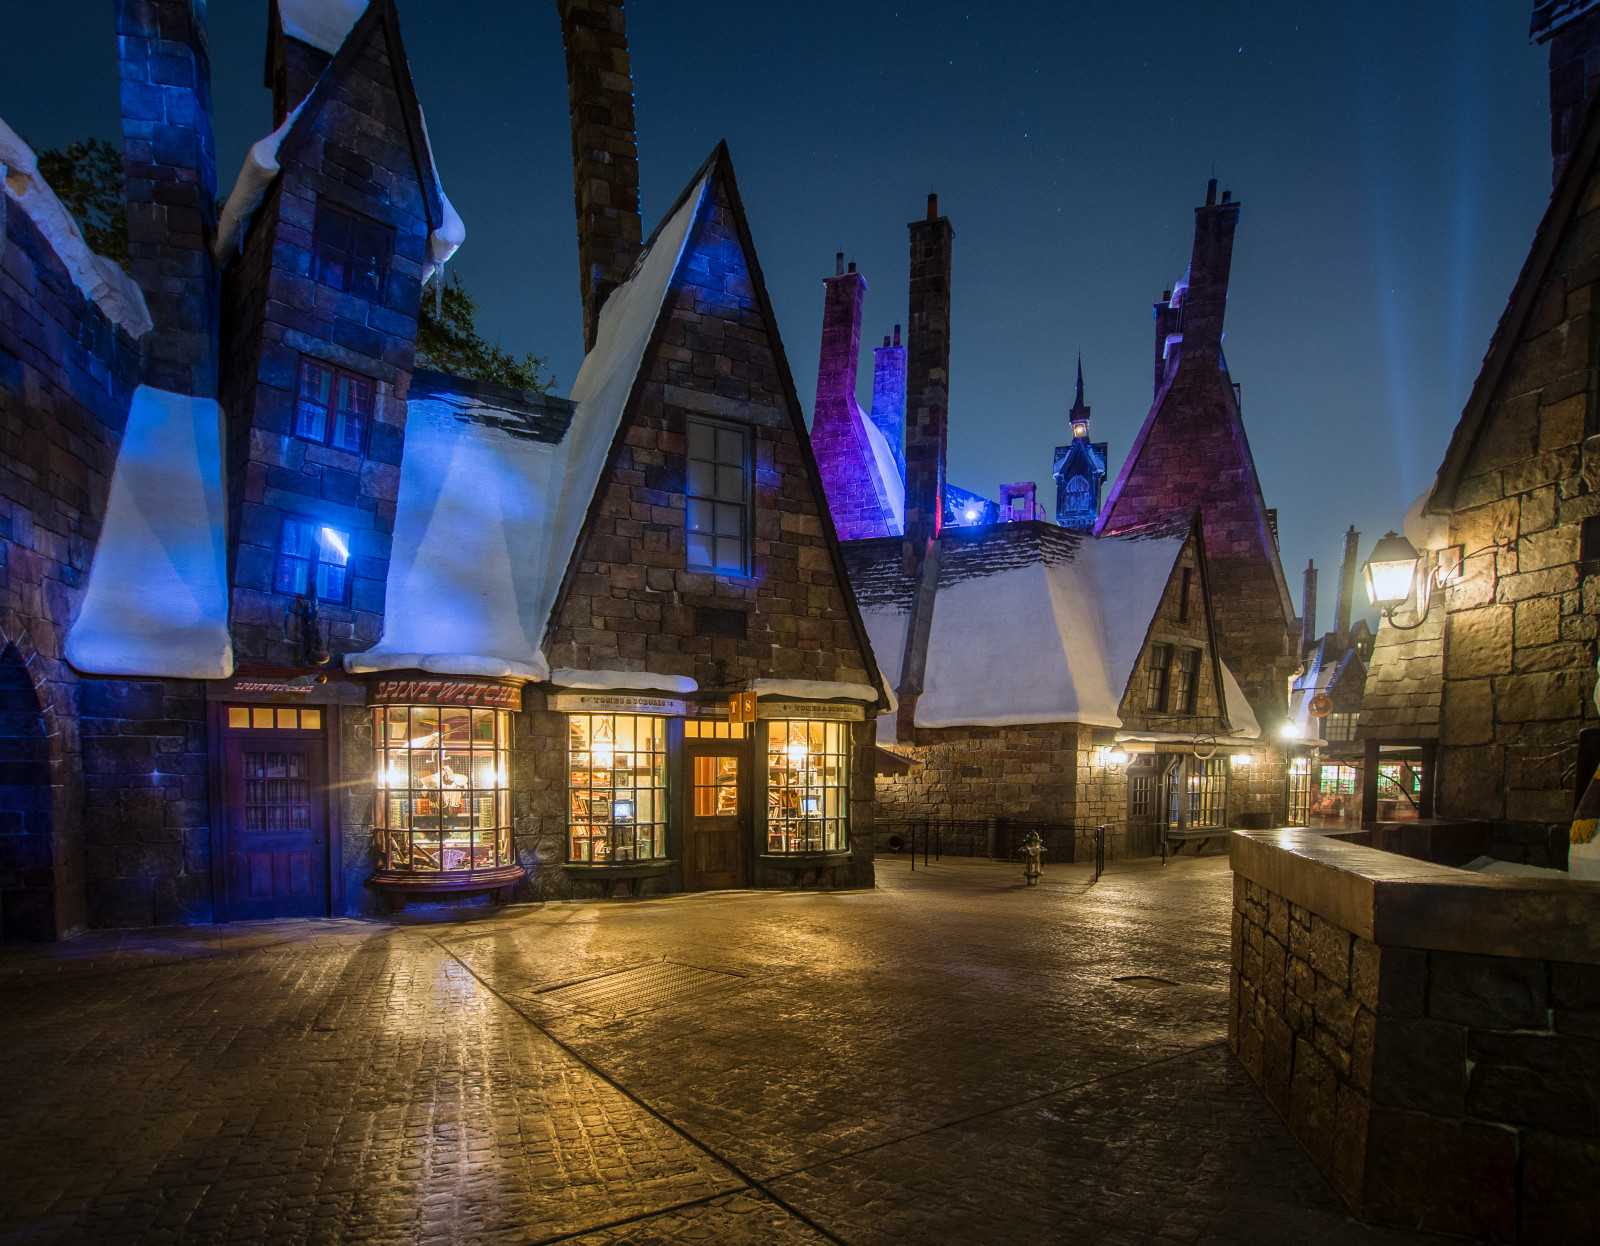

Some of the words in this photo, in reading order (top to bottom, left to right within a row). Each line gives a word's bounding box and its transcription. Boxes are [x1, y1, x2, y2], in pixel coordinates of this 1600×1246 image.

[633, 697, 666, 706] SCROLLS
[730, 701, 737, 713] T
[745, 700, 751, 712] S
